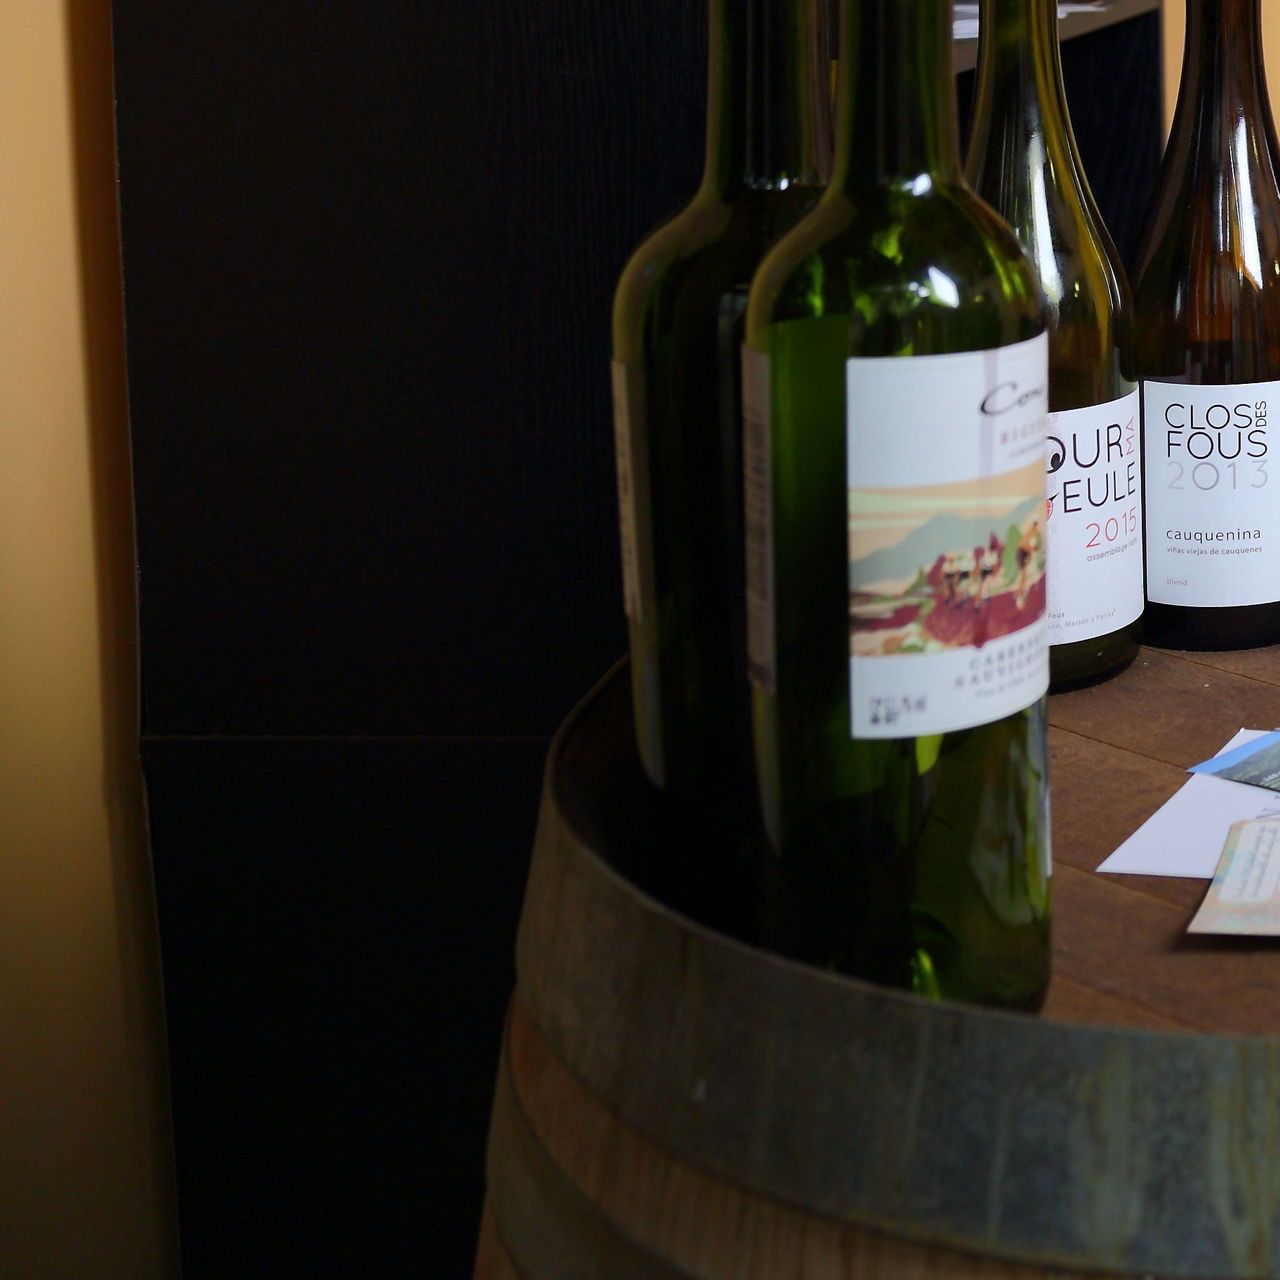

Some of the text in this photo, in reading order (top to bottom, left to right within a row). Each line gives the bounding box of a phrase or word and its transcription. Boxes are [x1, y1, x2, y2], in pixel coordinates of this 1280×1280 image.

[1165, 403, 1253, 430] CLOS
[1255, 400, 1267, 428] DES
[1047, 423, 1124, 474] OUR
[1167, 429, 1268, 460] FOUS
[1055, 460, 1136, 513] EULE
[1167, 460, 1269, 491] 2013
[1086, 506, 1137, 549] 2015
[1166, 528, 1262, 544] cauquenina
[1166, 546, 1263, 557] viñas viejas de cauquenes
[1166, 578, 1188, 586] blend
